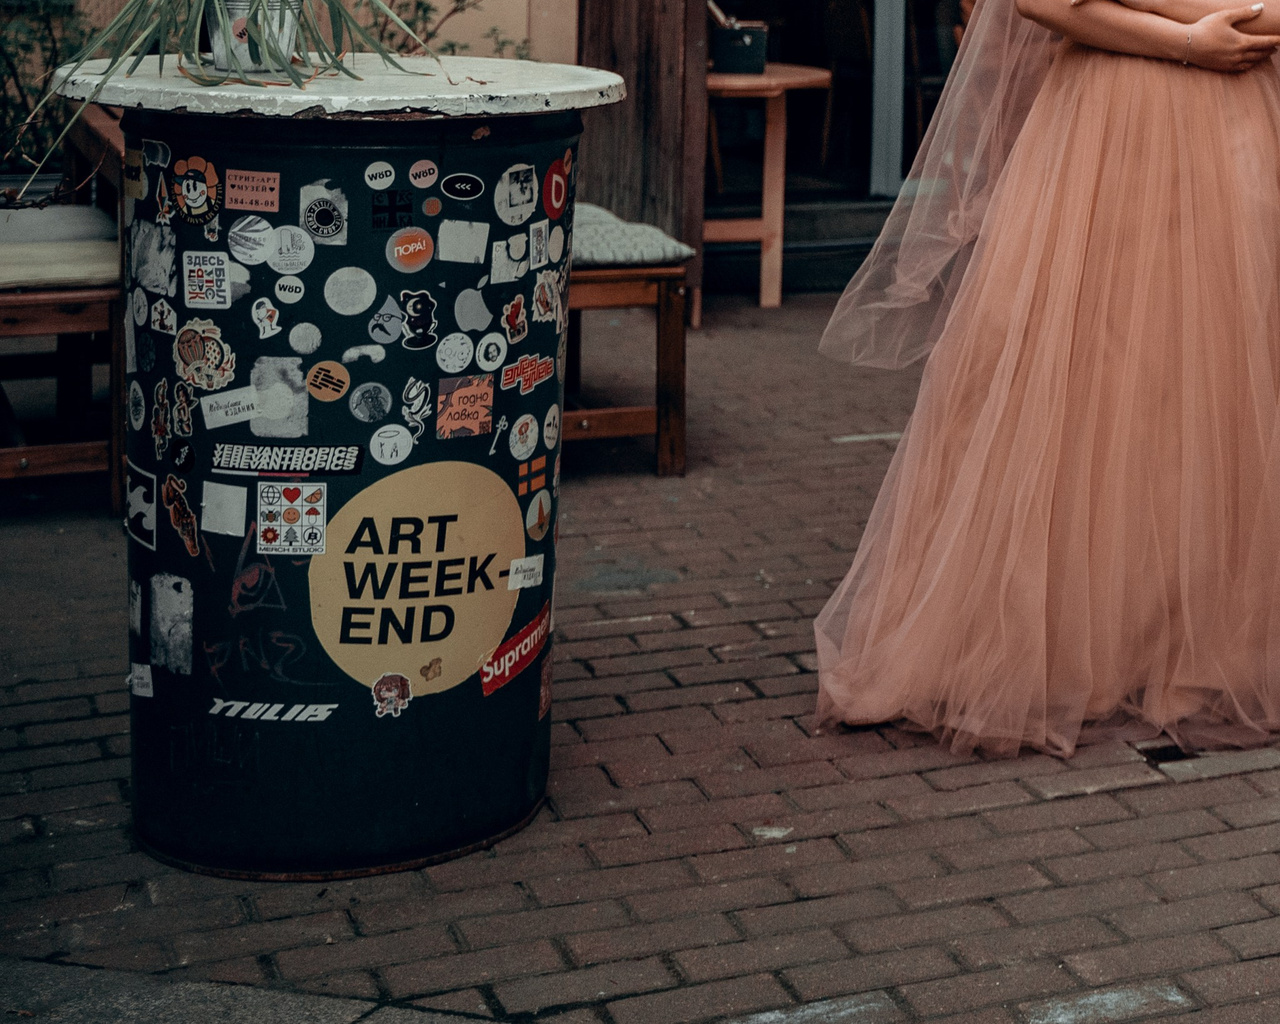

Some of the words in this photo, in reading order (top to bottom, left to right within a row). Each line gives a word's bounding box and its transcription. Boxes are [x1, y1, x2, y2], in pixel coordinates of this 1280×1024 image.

[227, 174, 277, 184] СТРИТ-АРТ
[236, 183, 266, 193] МУЗЕЙ
[227, 196, 275, 208] 384-48-08
[187, 255, 225, 267] ЗДЕСЬ
[215, 268, 227, 304] БЫЛ
[458, 392, 489, 407] годно
[446, 408, 479, 421] лавка
[345, 514, 458, 554] ART
[343, 553, 510, 600] WEEK-
[340, 604, 455, 645] END
